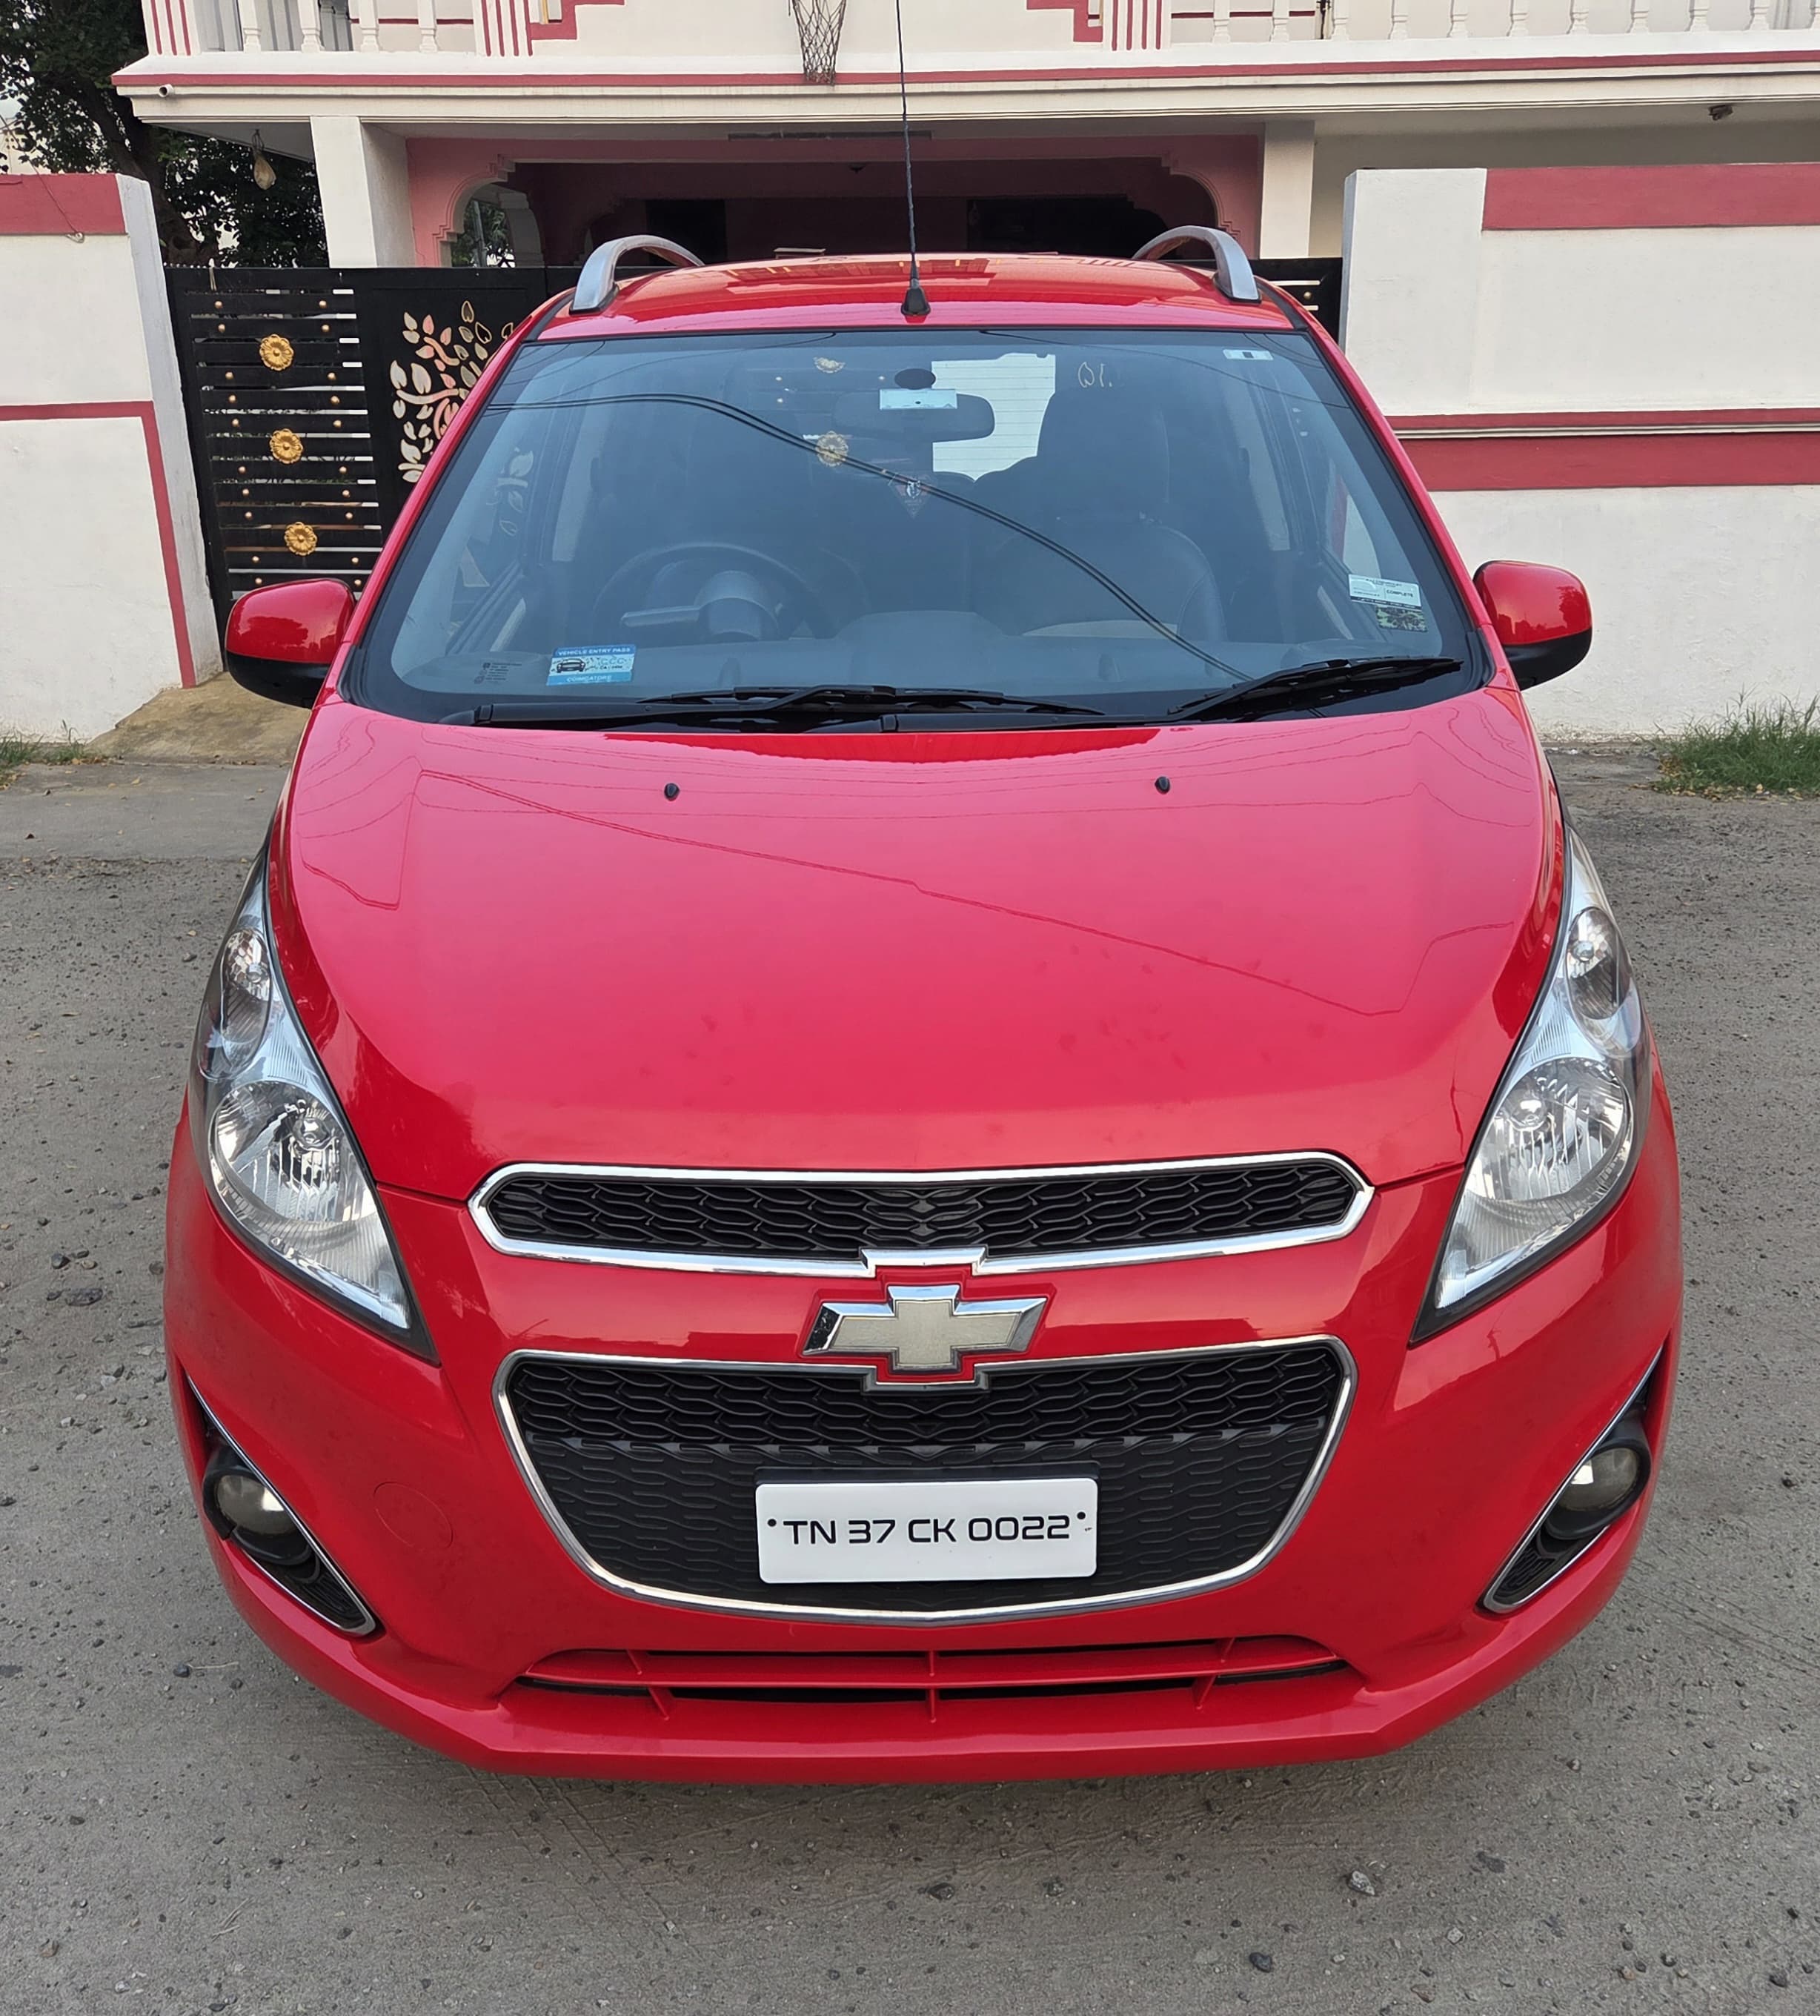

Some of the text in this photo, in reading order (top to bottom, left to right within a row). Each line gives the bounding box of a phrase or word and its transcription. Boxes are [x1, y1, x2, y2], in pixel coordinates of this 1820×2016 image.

[783, 1515, 1070, 1545] TN 37 CK 0022
